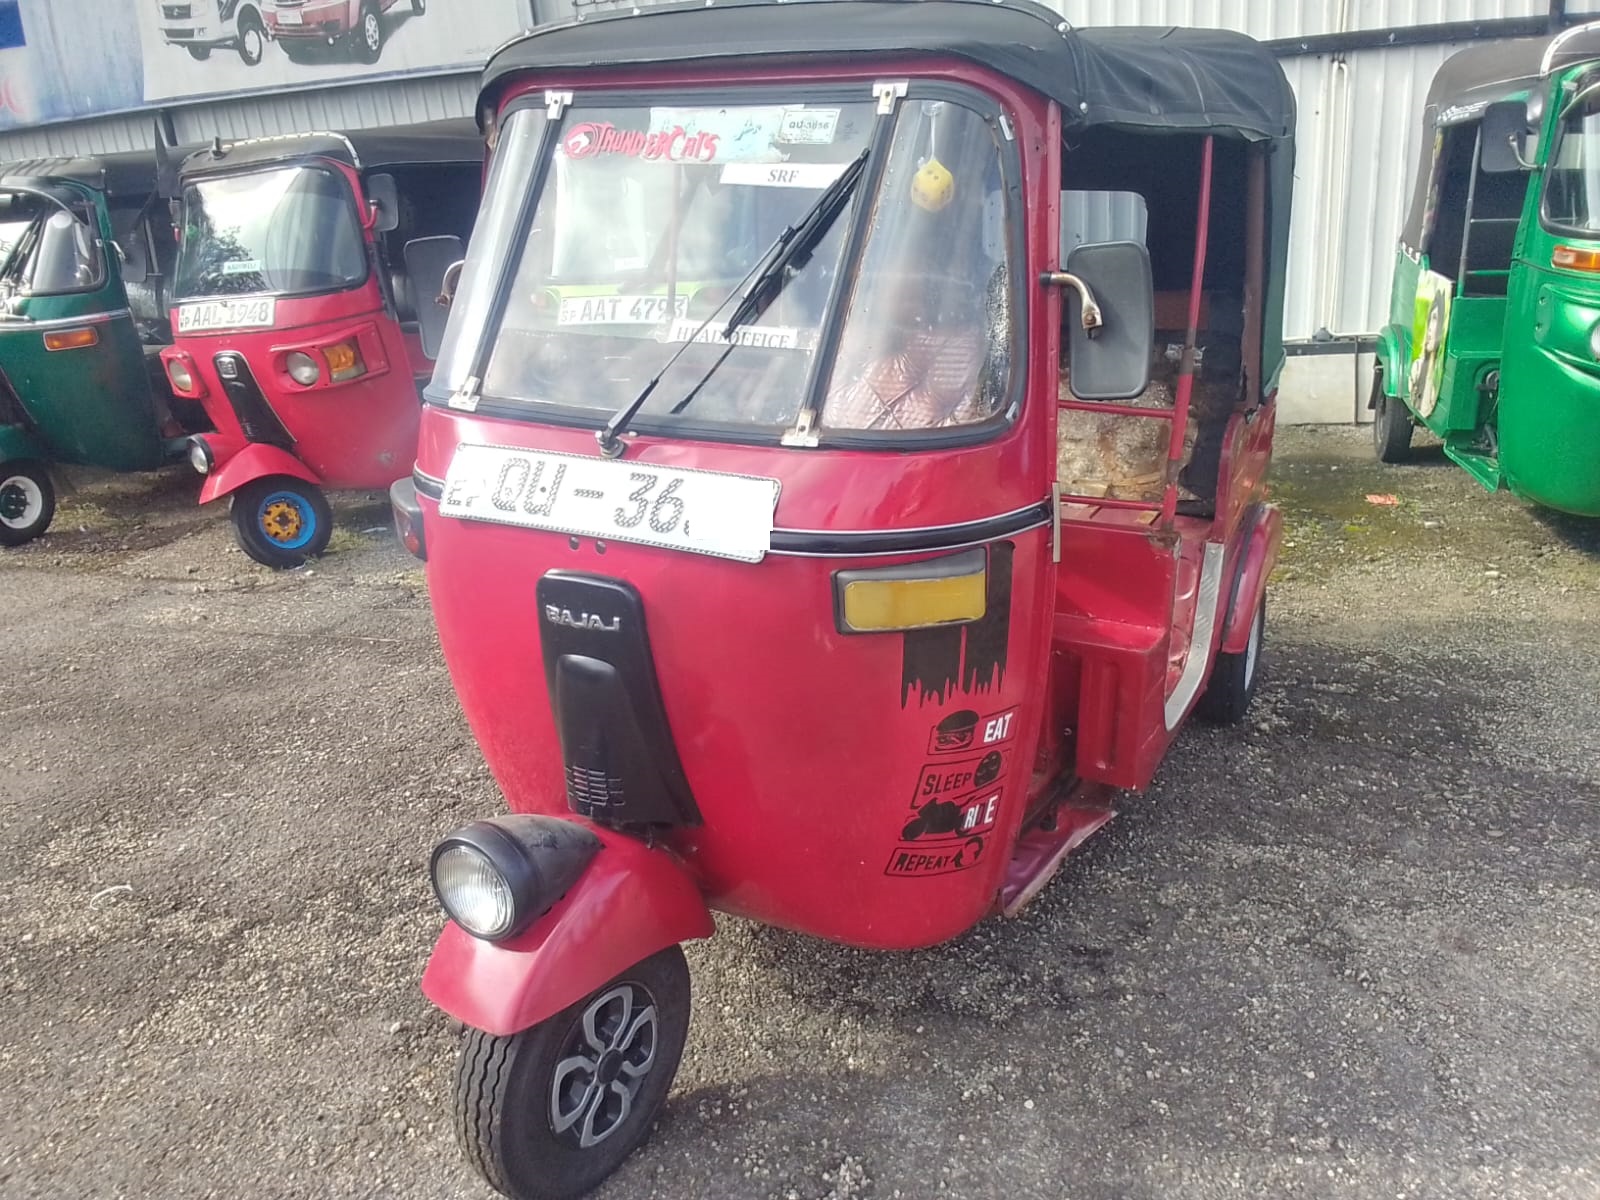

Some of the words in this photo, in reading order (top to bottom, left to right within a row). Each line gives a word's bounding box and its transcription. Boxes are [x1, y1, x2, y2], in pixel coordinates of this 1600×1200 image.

[767, 168, 800, 184] SRF
[580, 298, 623, 322] AAT
[545, 604, 621, 632] BAJAJ
[983, 712, 1014, 743] EAT
[922, 773, 973, 796] SLEEP
[893, 850, 952, 872] REPEAT
